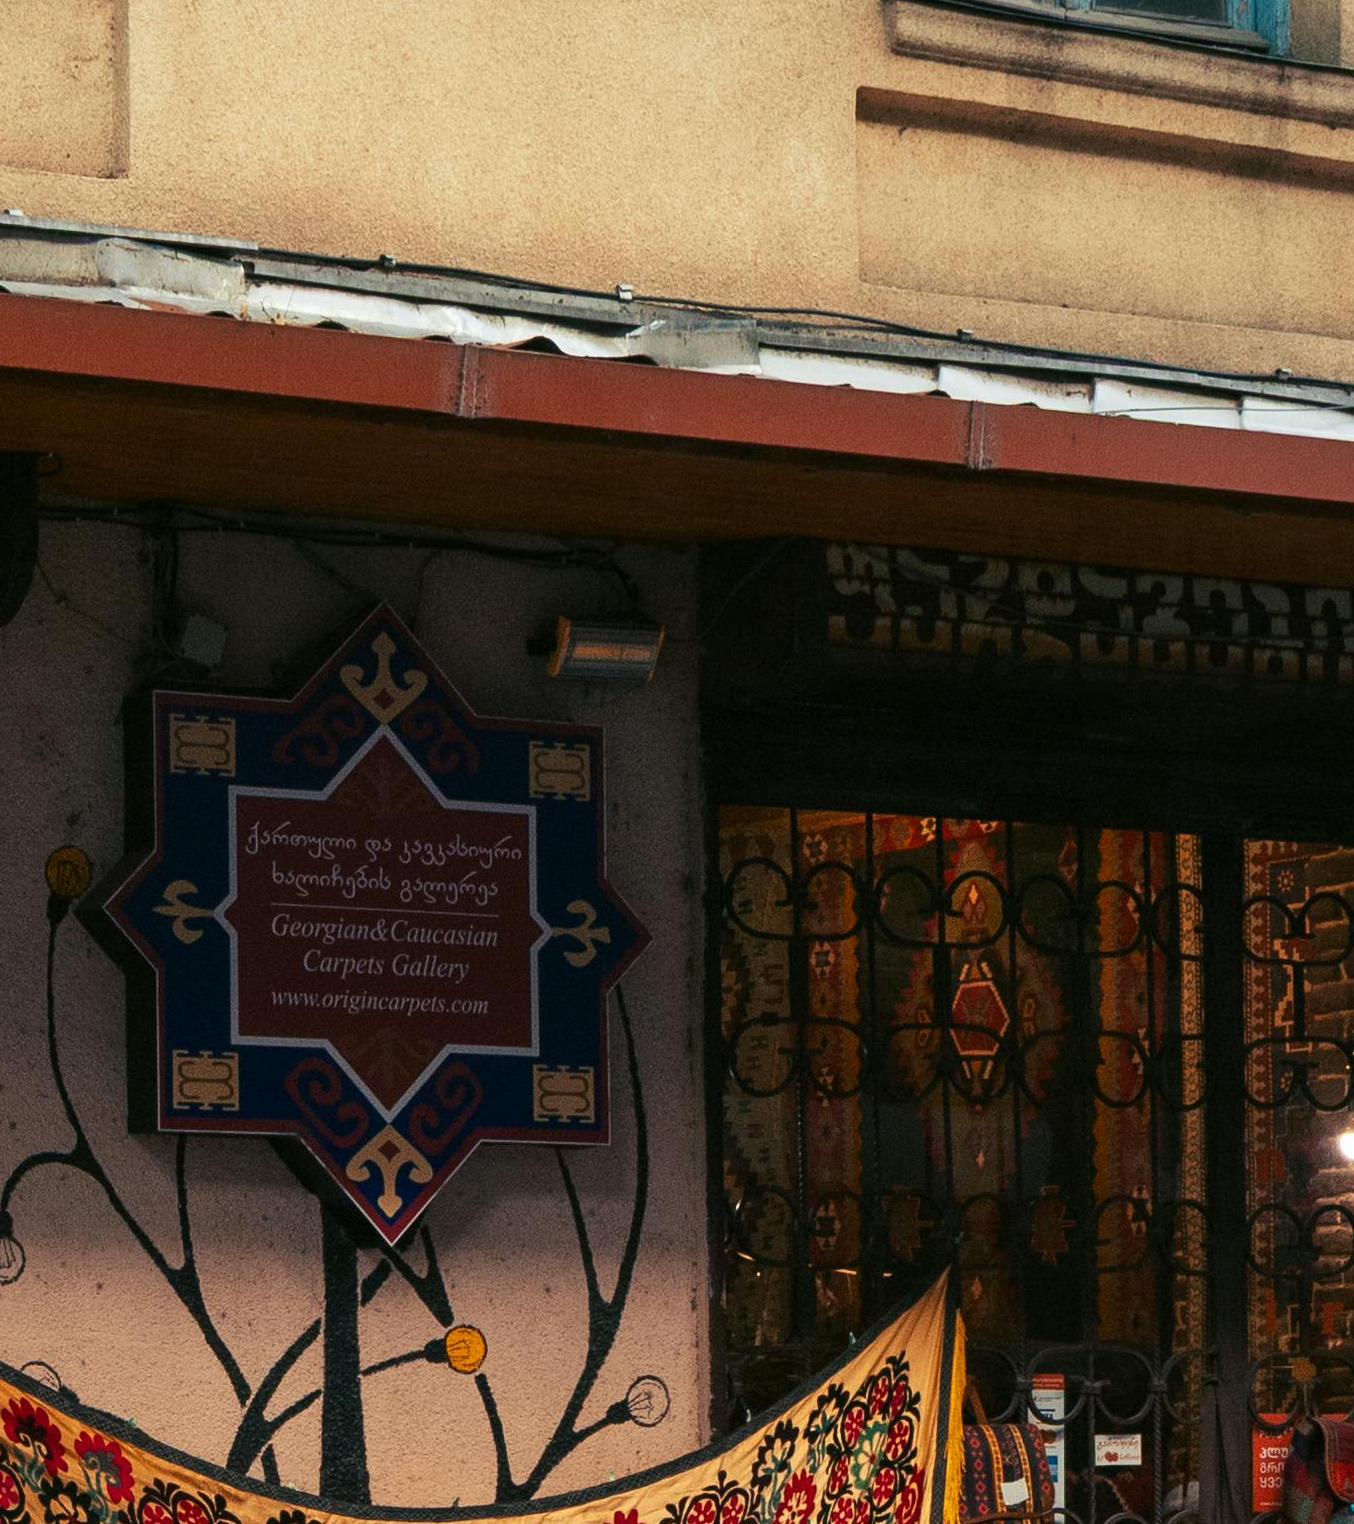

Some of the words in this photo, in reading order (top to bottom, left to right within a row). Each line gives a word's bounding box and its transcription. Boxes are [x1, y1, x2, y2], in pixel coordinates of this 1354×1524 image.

[246, 820, 356, 859] ქართული
[365, 837, 392, 862] და
[399, 834, 522, 869] კავკასიური
[272, 860, 391, 899] ხალიჩების
[400, 871, 498, 906] გალერეა
[272, 913, 498, 947] Georgian&Caucasian
[303, 949, 384, 980] Carpets
[392, 953, 469, 984] Gallery
[272, 989, 489, 1017] www.origincarpets.com
